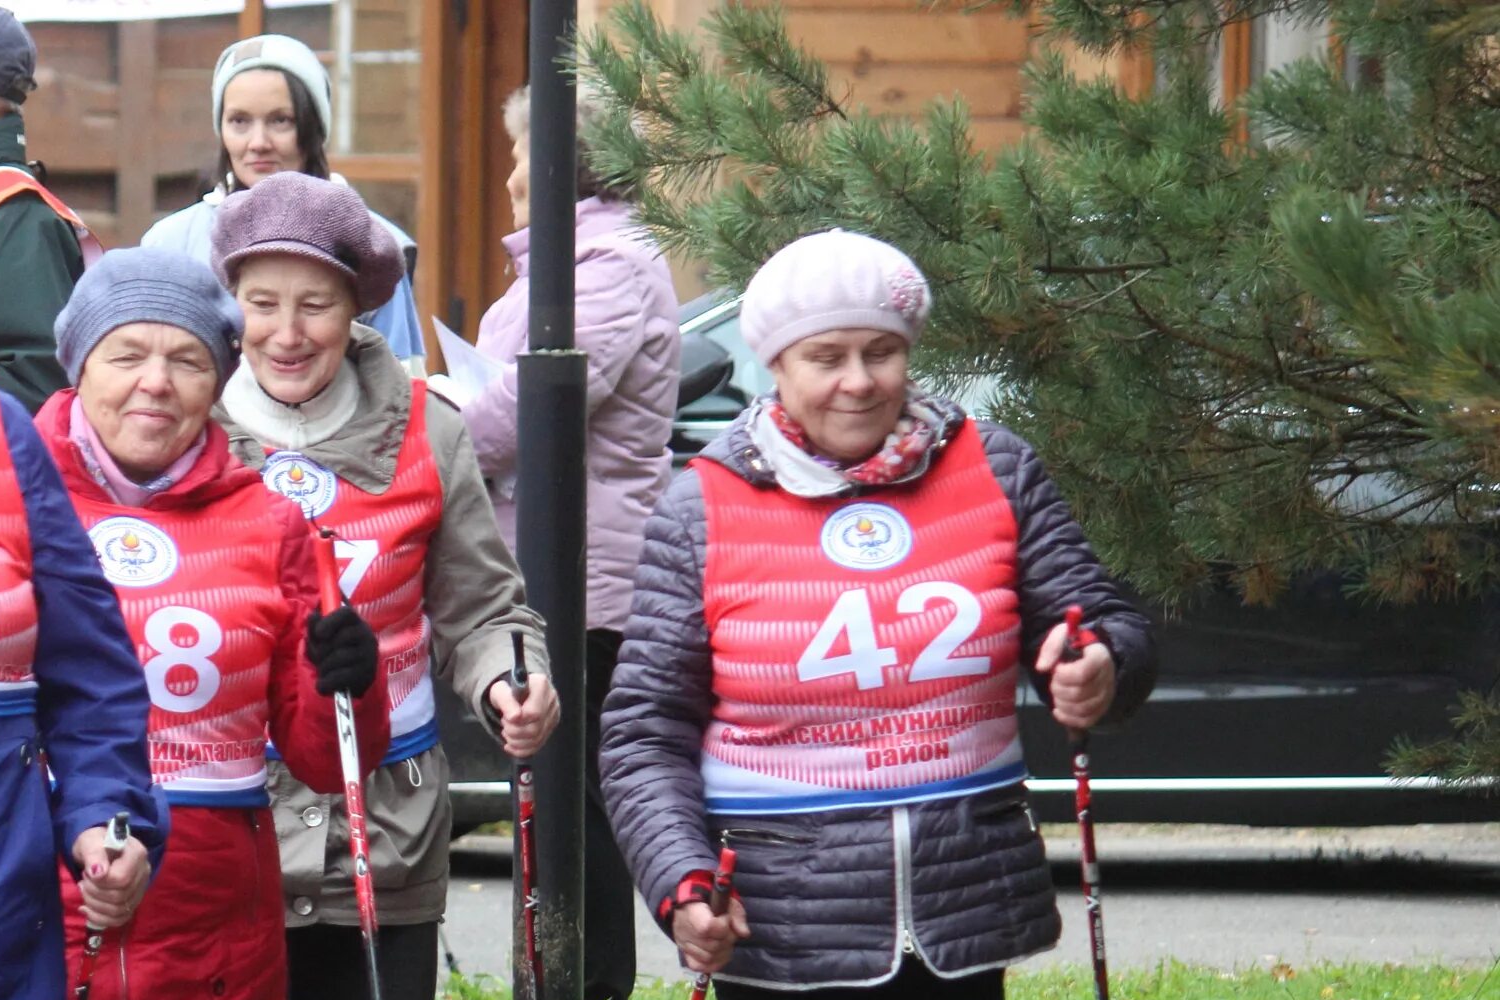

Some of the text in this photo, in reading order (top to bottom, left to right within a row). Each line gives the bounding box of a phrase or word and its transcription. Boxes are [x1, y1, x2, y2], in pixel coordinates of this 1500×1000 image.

[333, 538, 380, 608] 7
[143, 605, 223, 713] 8
[796, 580, 991, 691] 42
[866, 739, 950, 771] район
